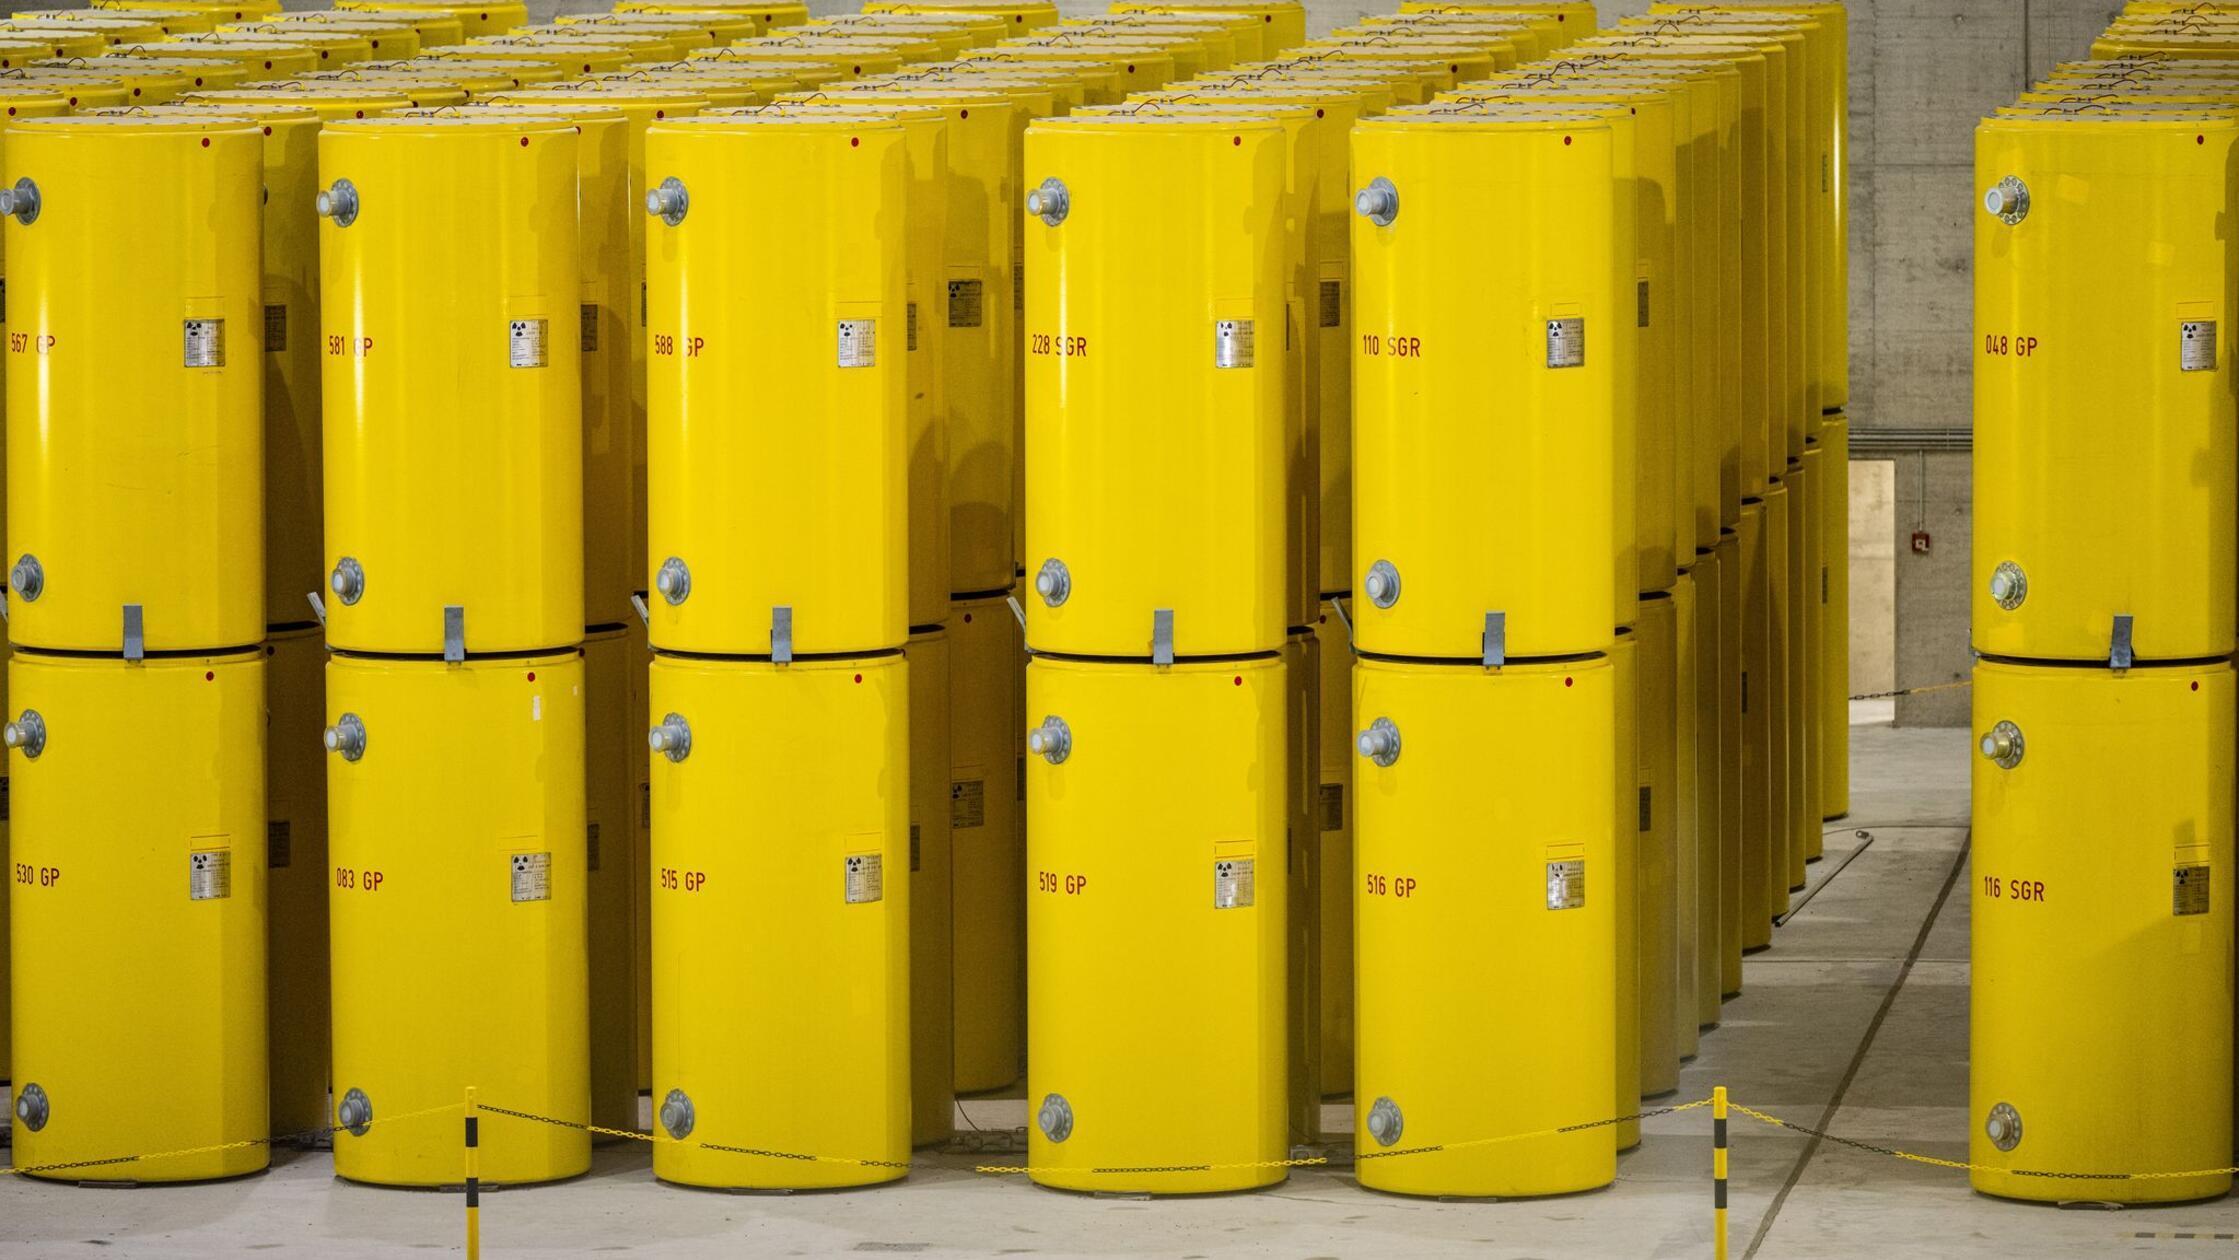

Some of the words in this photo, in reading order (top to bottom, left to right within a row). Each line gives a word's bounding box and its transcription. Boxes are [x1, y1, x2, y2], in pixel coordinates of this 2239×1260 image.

[11, 332, 27, 353] 567
[328, 335, 345, 355] 581
[655, 334, 673, 355] 588
[1032, 334, 1050, 355] 228
[1055, 336, 1087, 357] SGR
[1363, 335, 1379, 355] 110
[1388, 337, 1421, 357] SGR
[1986, 334, 2008, 355] 048
[2016, 336, 2038, 357] GP
[16, 863, 34, 885] 530
[40, 867, 60, 887] GP
[336, 867, 354, 889] 083
[363, 871, 384, 891] GP
[661, 868, 678, 890] 515
[685, 871, 706, 892] GP
[1039, 871, 1057, 893] 519
[1065, 874, 1087, 895] GP
[1367, 873, 1386, 896] 516
[1395, 877, 1416, 898] GP
[1984, 875, 2001, 898] 116
[2010, 879, 2045, 902] SGR
